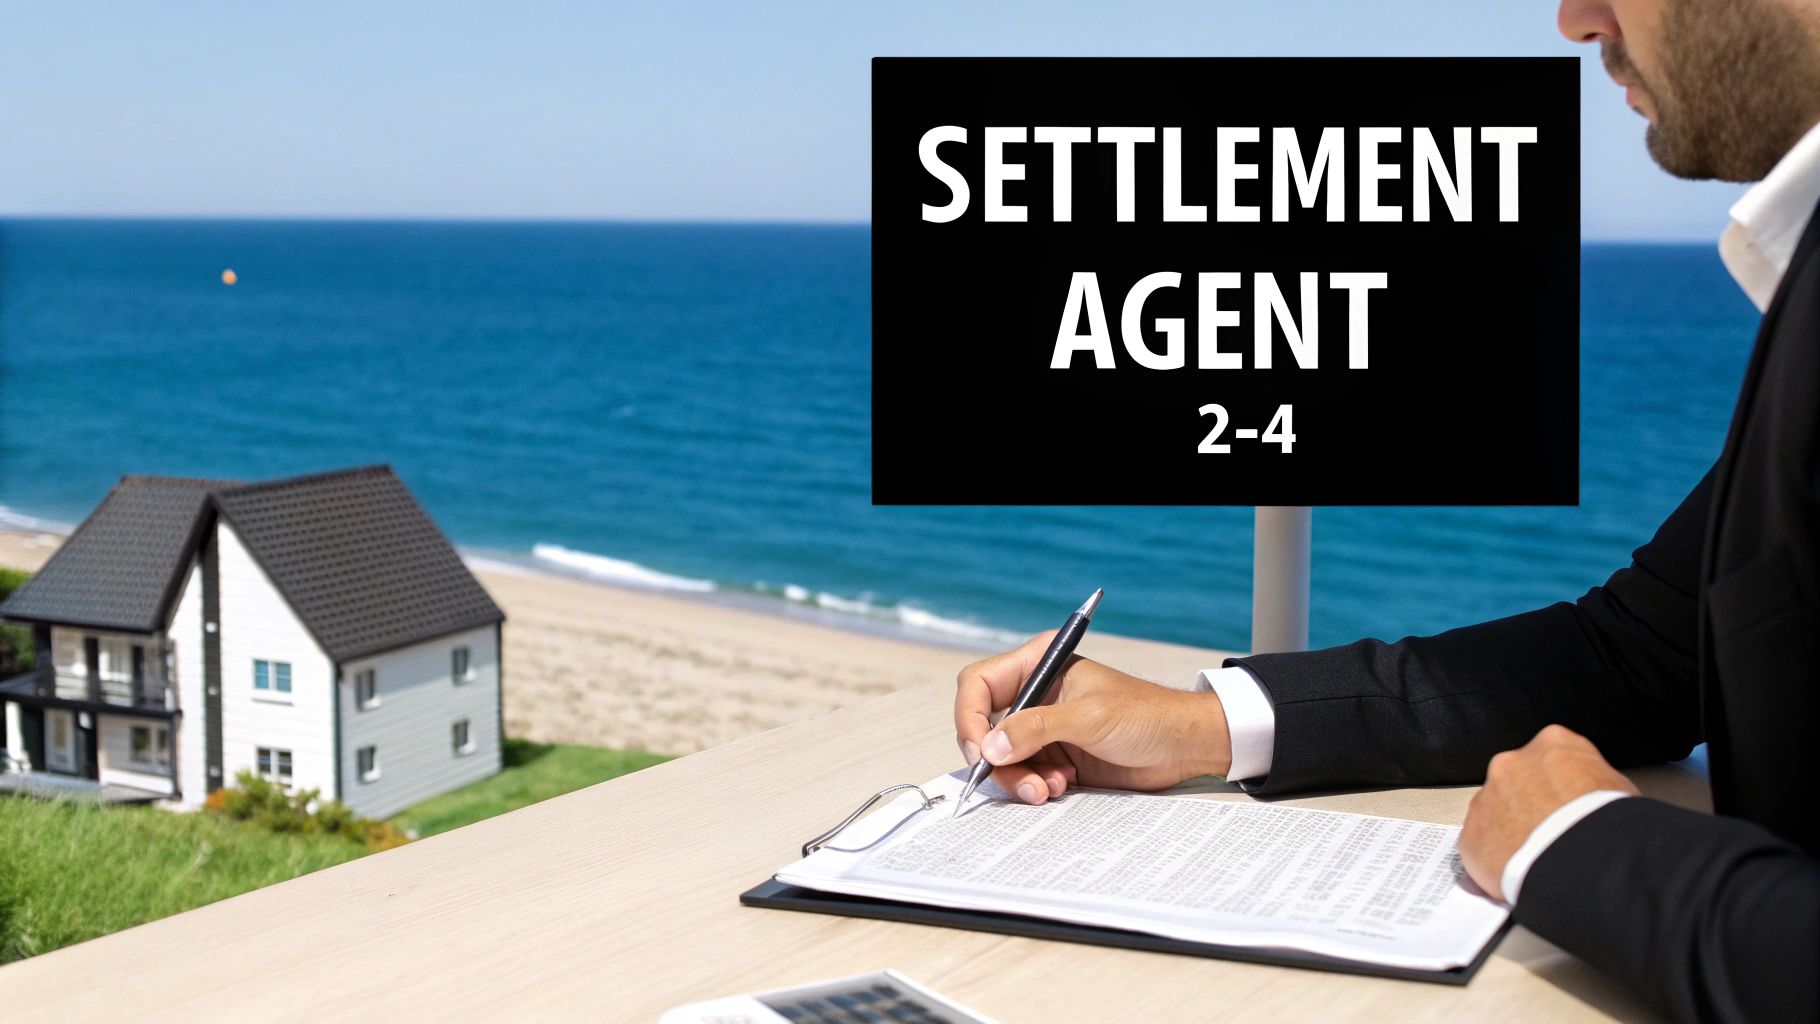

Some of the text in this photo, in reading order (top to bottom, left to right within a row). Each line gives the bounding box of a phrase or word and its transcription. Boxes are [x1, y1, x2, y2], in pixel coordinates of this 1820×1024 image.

[918, 125, 1538, 224] SETTLEMENT
[1050, 271, 1388, 371] AGENT
[1197, 403, 1297, 454] 2-4
